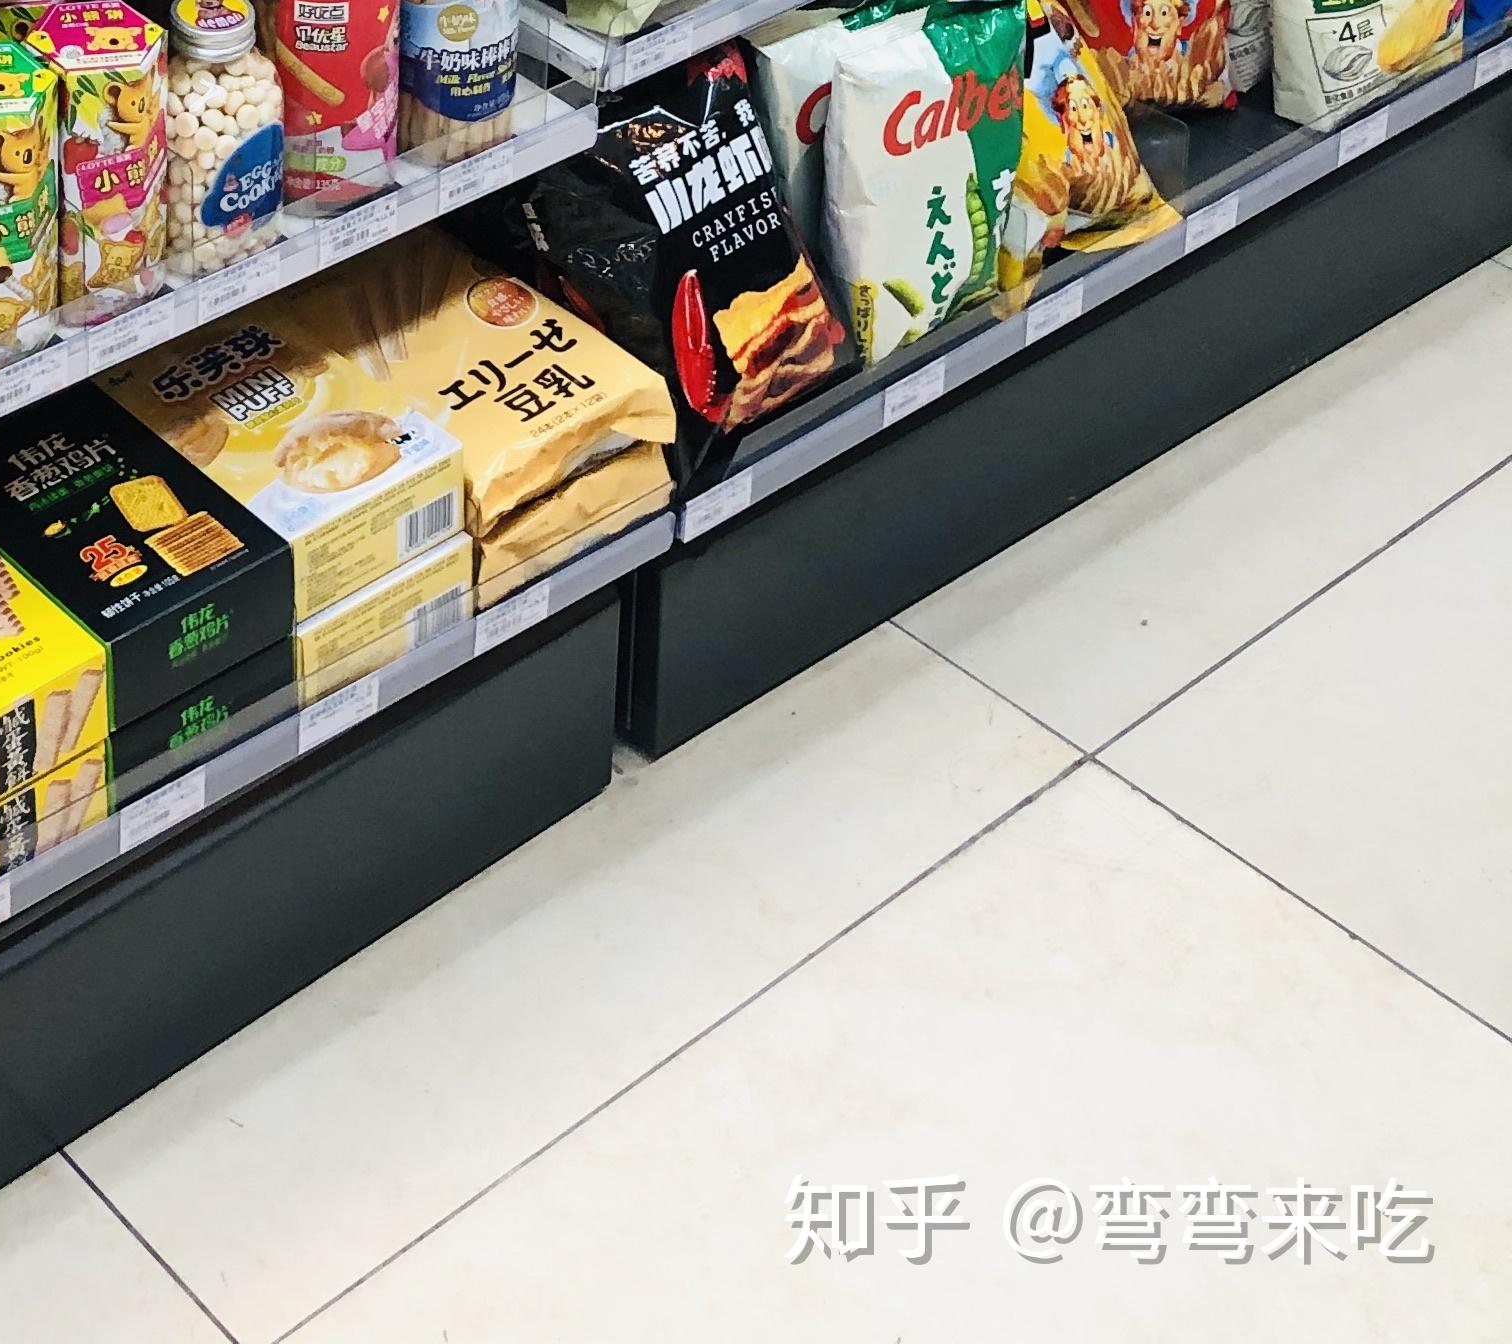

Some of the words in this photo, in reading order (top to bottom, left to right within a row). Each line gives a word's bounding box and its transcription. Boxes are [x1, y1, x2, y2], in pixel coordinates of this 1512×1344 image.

[710, 213, 780, 261] FLAVOR
[438, 318, 577, 411] エリーゼ
[210, 368, 286, 410] MINI
[230, 380, 295, 422] PUFF
[498, 359, 597, 425] 豆乳
[3, 438, 120, 502] 香葱鸡片
[7, 431, 65, 474] 伟龙
